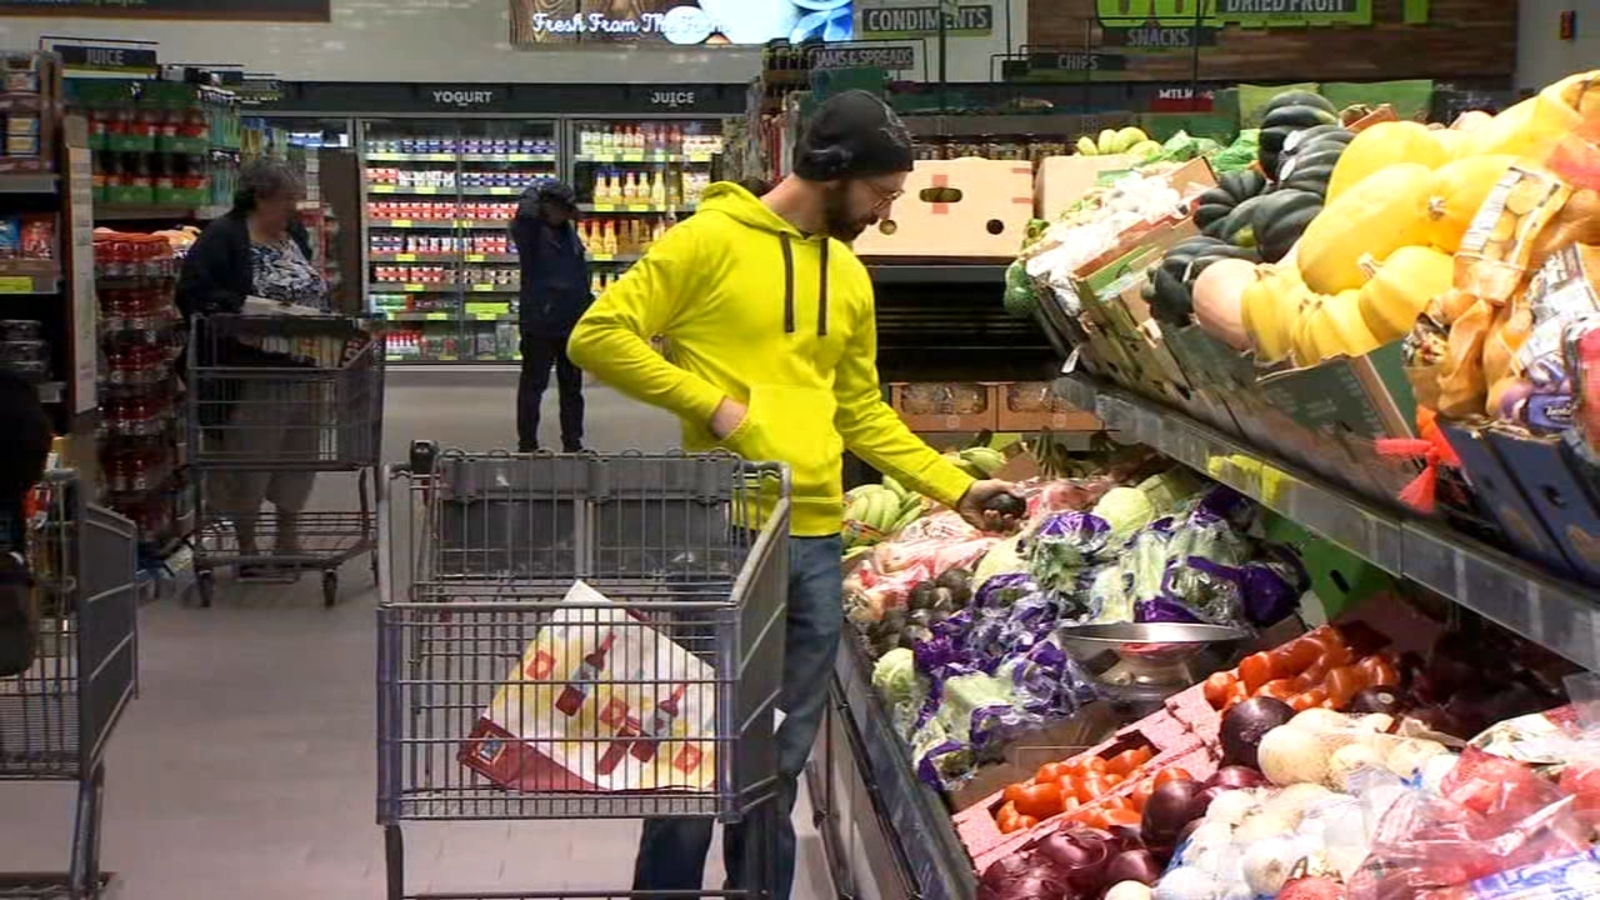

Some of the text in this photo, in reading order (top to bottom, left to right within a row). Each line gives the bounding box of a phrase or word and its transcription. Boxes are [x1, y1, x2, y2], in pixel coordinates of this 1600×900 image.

[1227, 0, 1344, 11] DRIED FRUIT
[532, 12, 586, 32] Fresh
[589, 13, 641, 32] From
[1126, 28, 1190, 46] SNACKS
[86, 49, 125, 66] JUICE
[1058, 54, 1099, 70] CHIPS
[433, 91, 493, 105] YOGURT
[651, 91, 695, 105] JUICE
